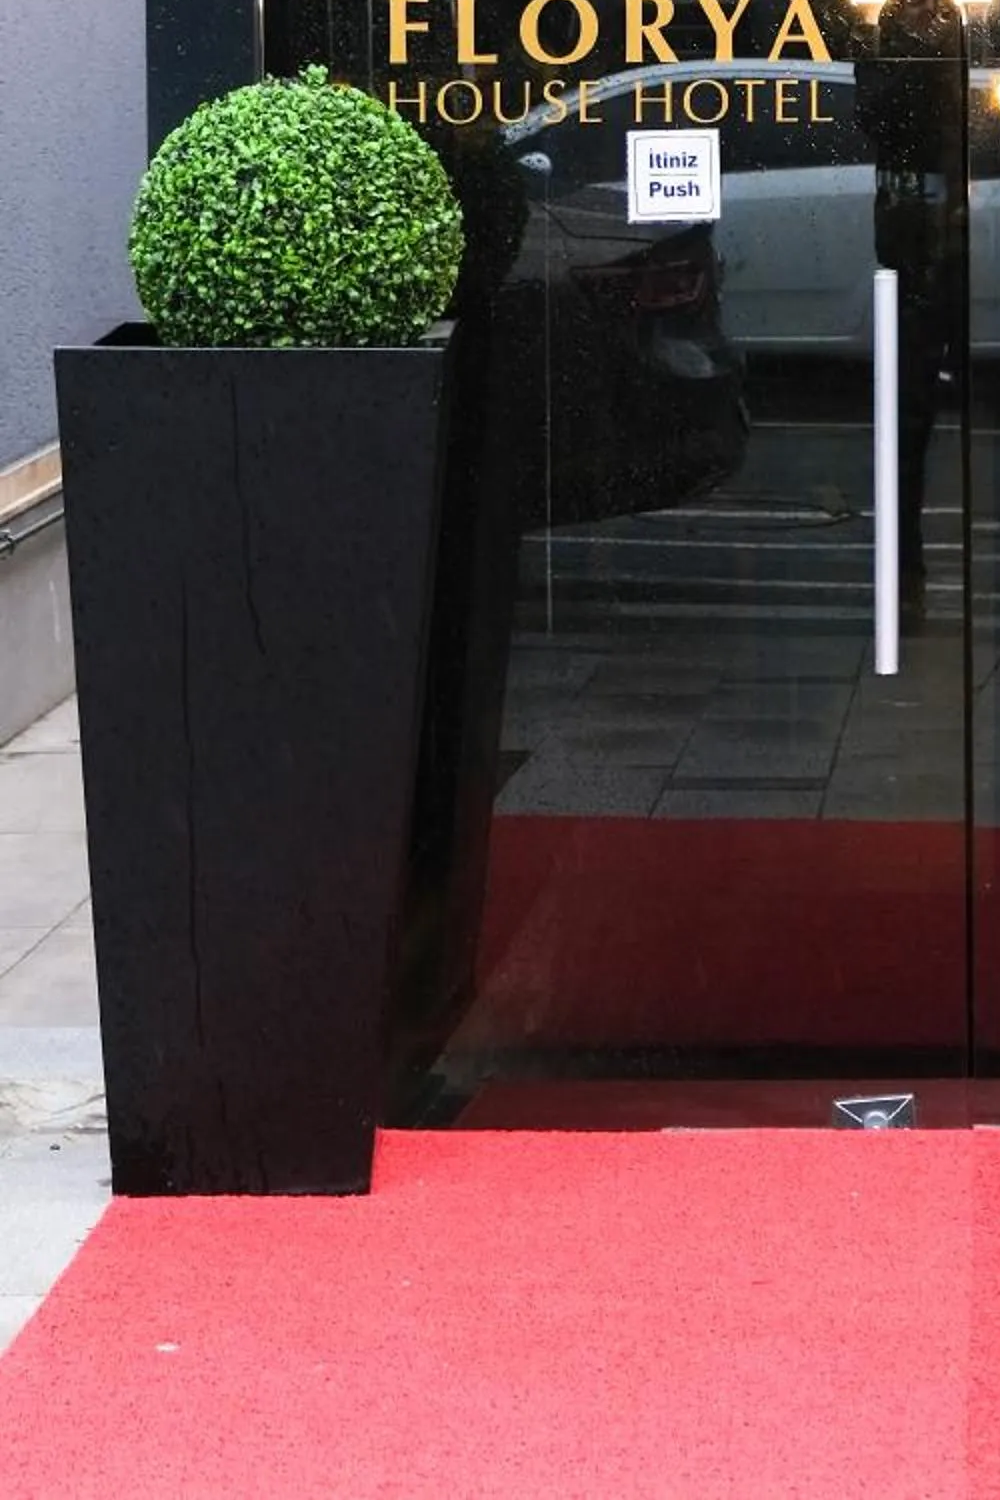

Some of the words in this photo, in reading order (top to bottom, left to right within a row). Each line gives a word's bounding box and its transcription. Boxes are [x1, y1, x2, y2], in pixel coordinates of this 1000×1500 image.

[388, 79, 603, 125] HOUSE
[634, 78, 835, 124] HOTEL
[649, 147, 698, 169] İtiniz
[649, 180, 701, 198] Push
